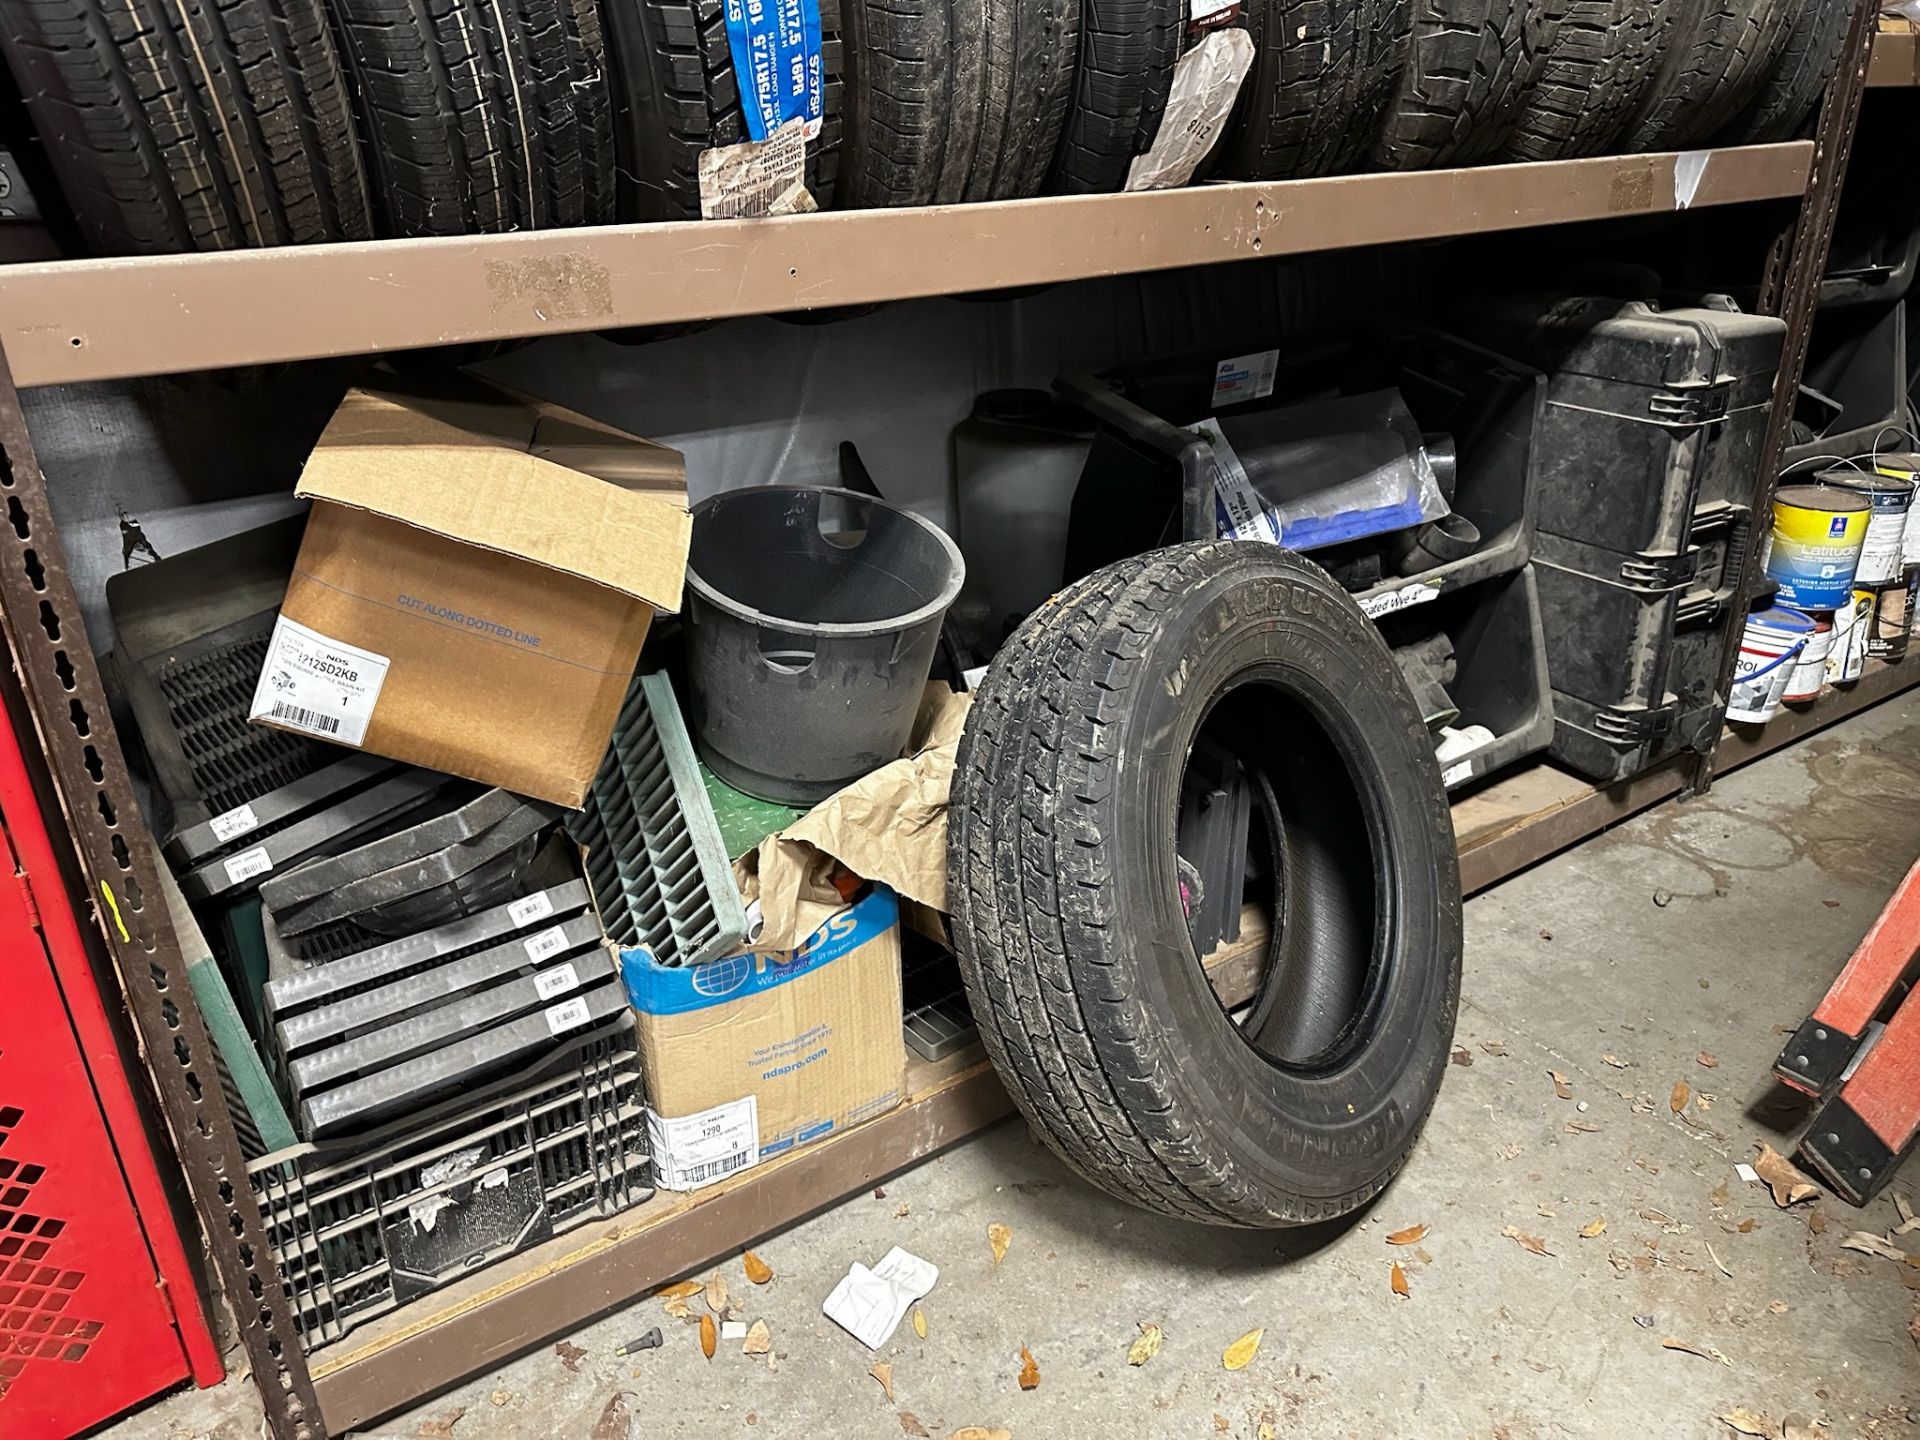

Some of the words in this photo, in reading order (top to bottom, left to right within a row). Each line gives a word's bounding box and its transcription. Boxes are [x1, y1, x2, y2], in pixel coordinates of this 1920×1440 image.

[778, 6, 787, 38] RANGE
[769, 40, 777, 71] RANGE
[771, 73, 779, 96] LOAD
[791, 53, 805, 96] 16PR
[809, 54, 820, 116] S737SP
[764, 161, 783, 173] EVANS
[1235, 490, 1249, 510] Filter
[1801, 544, 1858, 557] Latitude
[397, 594, 423, 609] CUT
[423, 603, 465, 623] ALONG
[466, 616, 513, 638] DOTTED
[515, 631, 541, 646] LINE
[326, 654, 349, 666] NDS
[341, 696, 348, 706] 1
[755, 908, 858, 974] NDS
[747, 1054, 773, 1067] Trusted
[774, 1046, 800, 1059] Partner
[763, 1048, 828, 1080] ndspro.com
